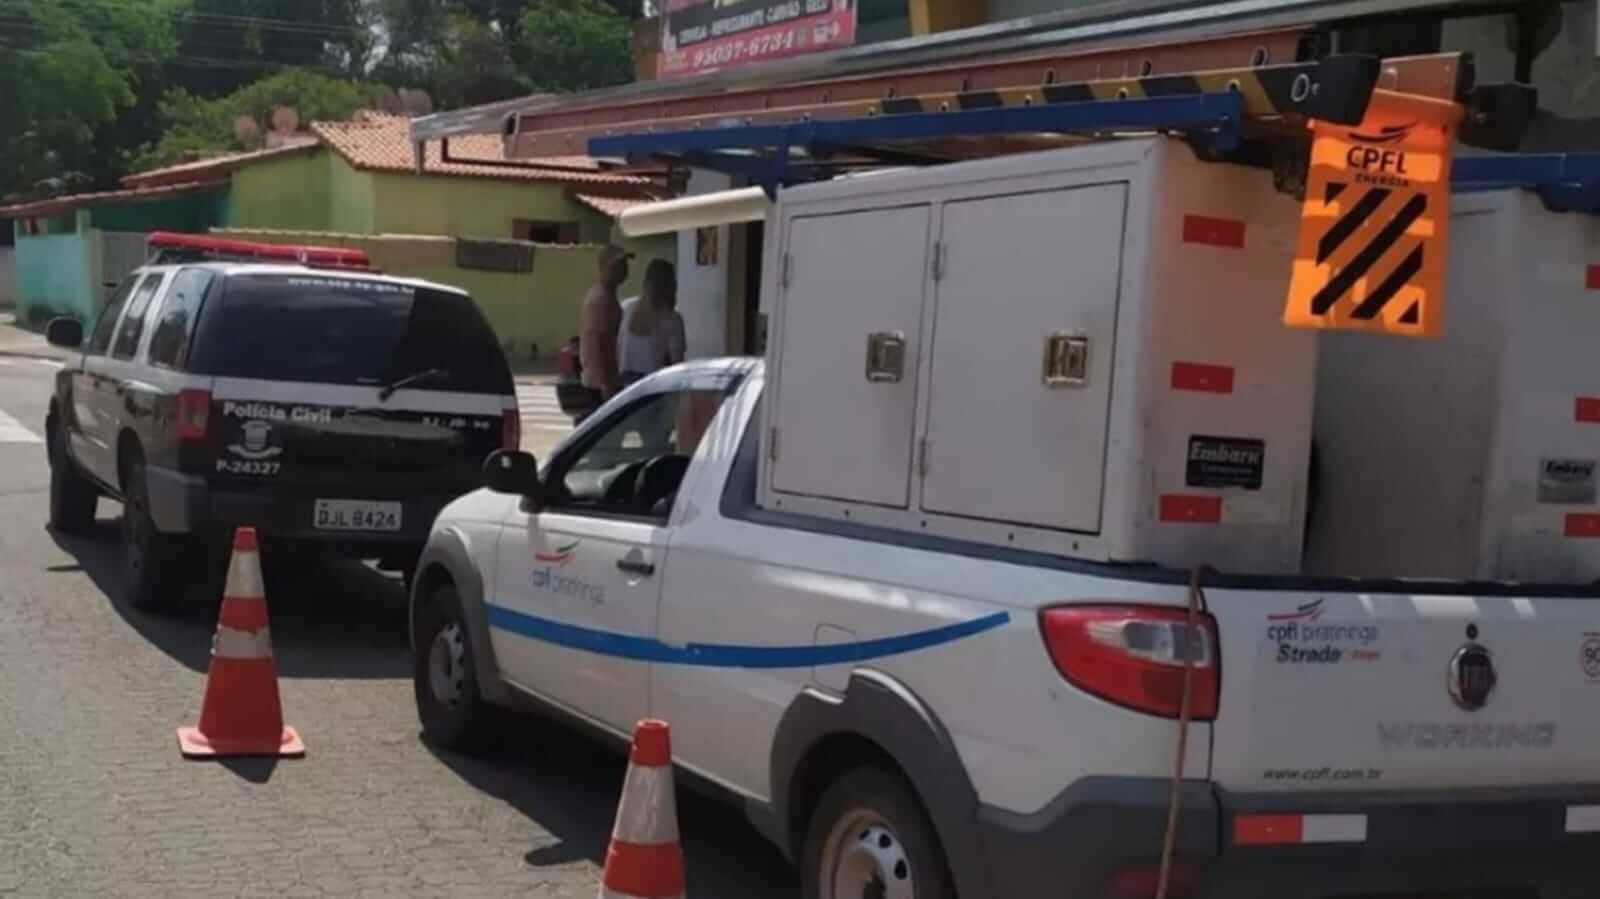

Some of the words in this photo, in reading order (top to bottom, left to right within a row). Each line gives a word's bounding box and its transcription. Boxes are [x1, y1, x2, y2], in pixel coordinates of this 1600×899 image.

[1346, 145, 1407, 174] CPFL
[222, 401, 287, 420] Polícia
[290, 405, 332, 424] Civil
[1276, 643, 1343, 664] Strada
[1376, 721, 1557, 749] WORKING
